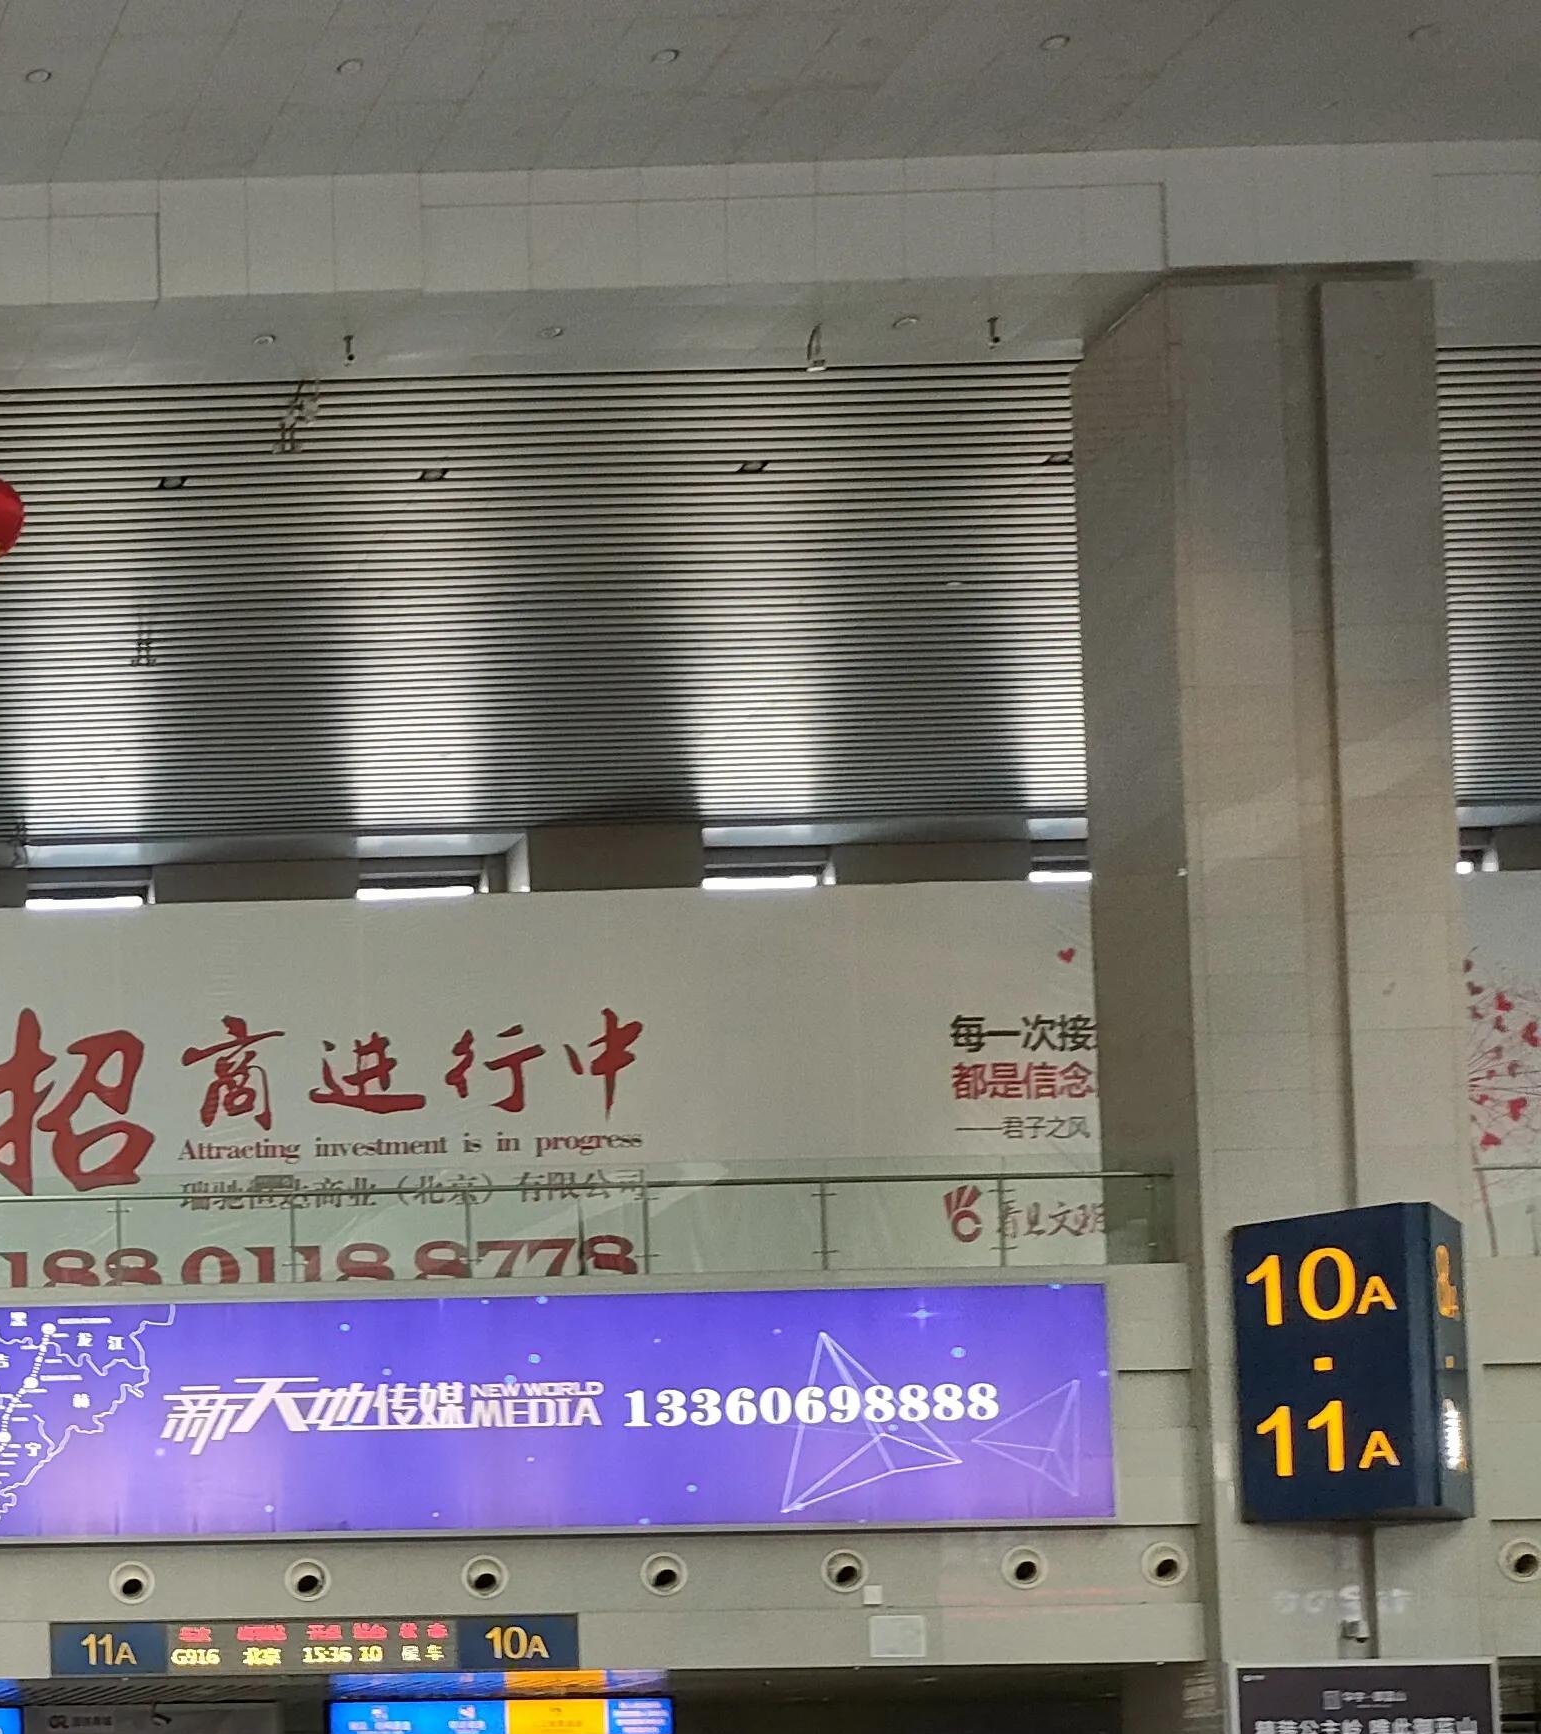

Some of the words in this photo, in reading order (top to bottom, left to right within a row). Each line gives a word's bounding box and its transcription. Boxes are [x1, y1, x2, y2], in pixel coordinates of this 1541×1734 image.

[952, 1061, 1094, 1099] 都是信念
[178, 1138, 301, 1163] Attracting
[314, 1136, 448, 1158] investment
[463, 1134, 482, 1154] is
[496, 1133, 520, 1153] in
[534, 1132, 644, 1158] progress
[1244, 1246, 1399, 1328] 10A
[470, 1397, 603, 1428] MEDIA
[622, 1382, 1001, 1430] 13360698888
[1254, 1399, 1402, 1479] 11A
[80, 1632, 138, 1666] 11A
[171, 1647, 221, 1666] G916
[484, 1626, 551, 1660] 10A
